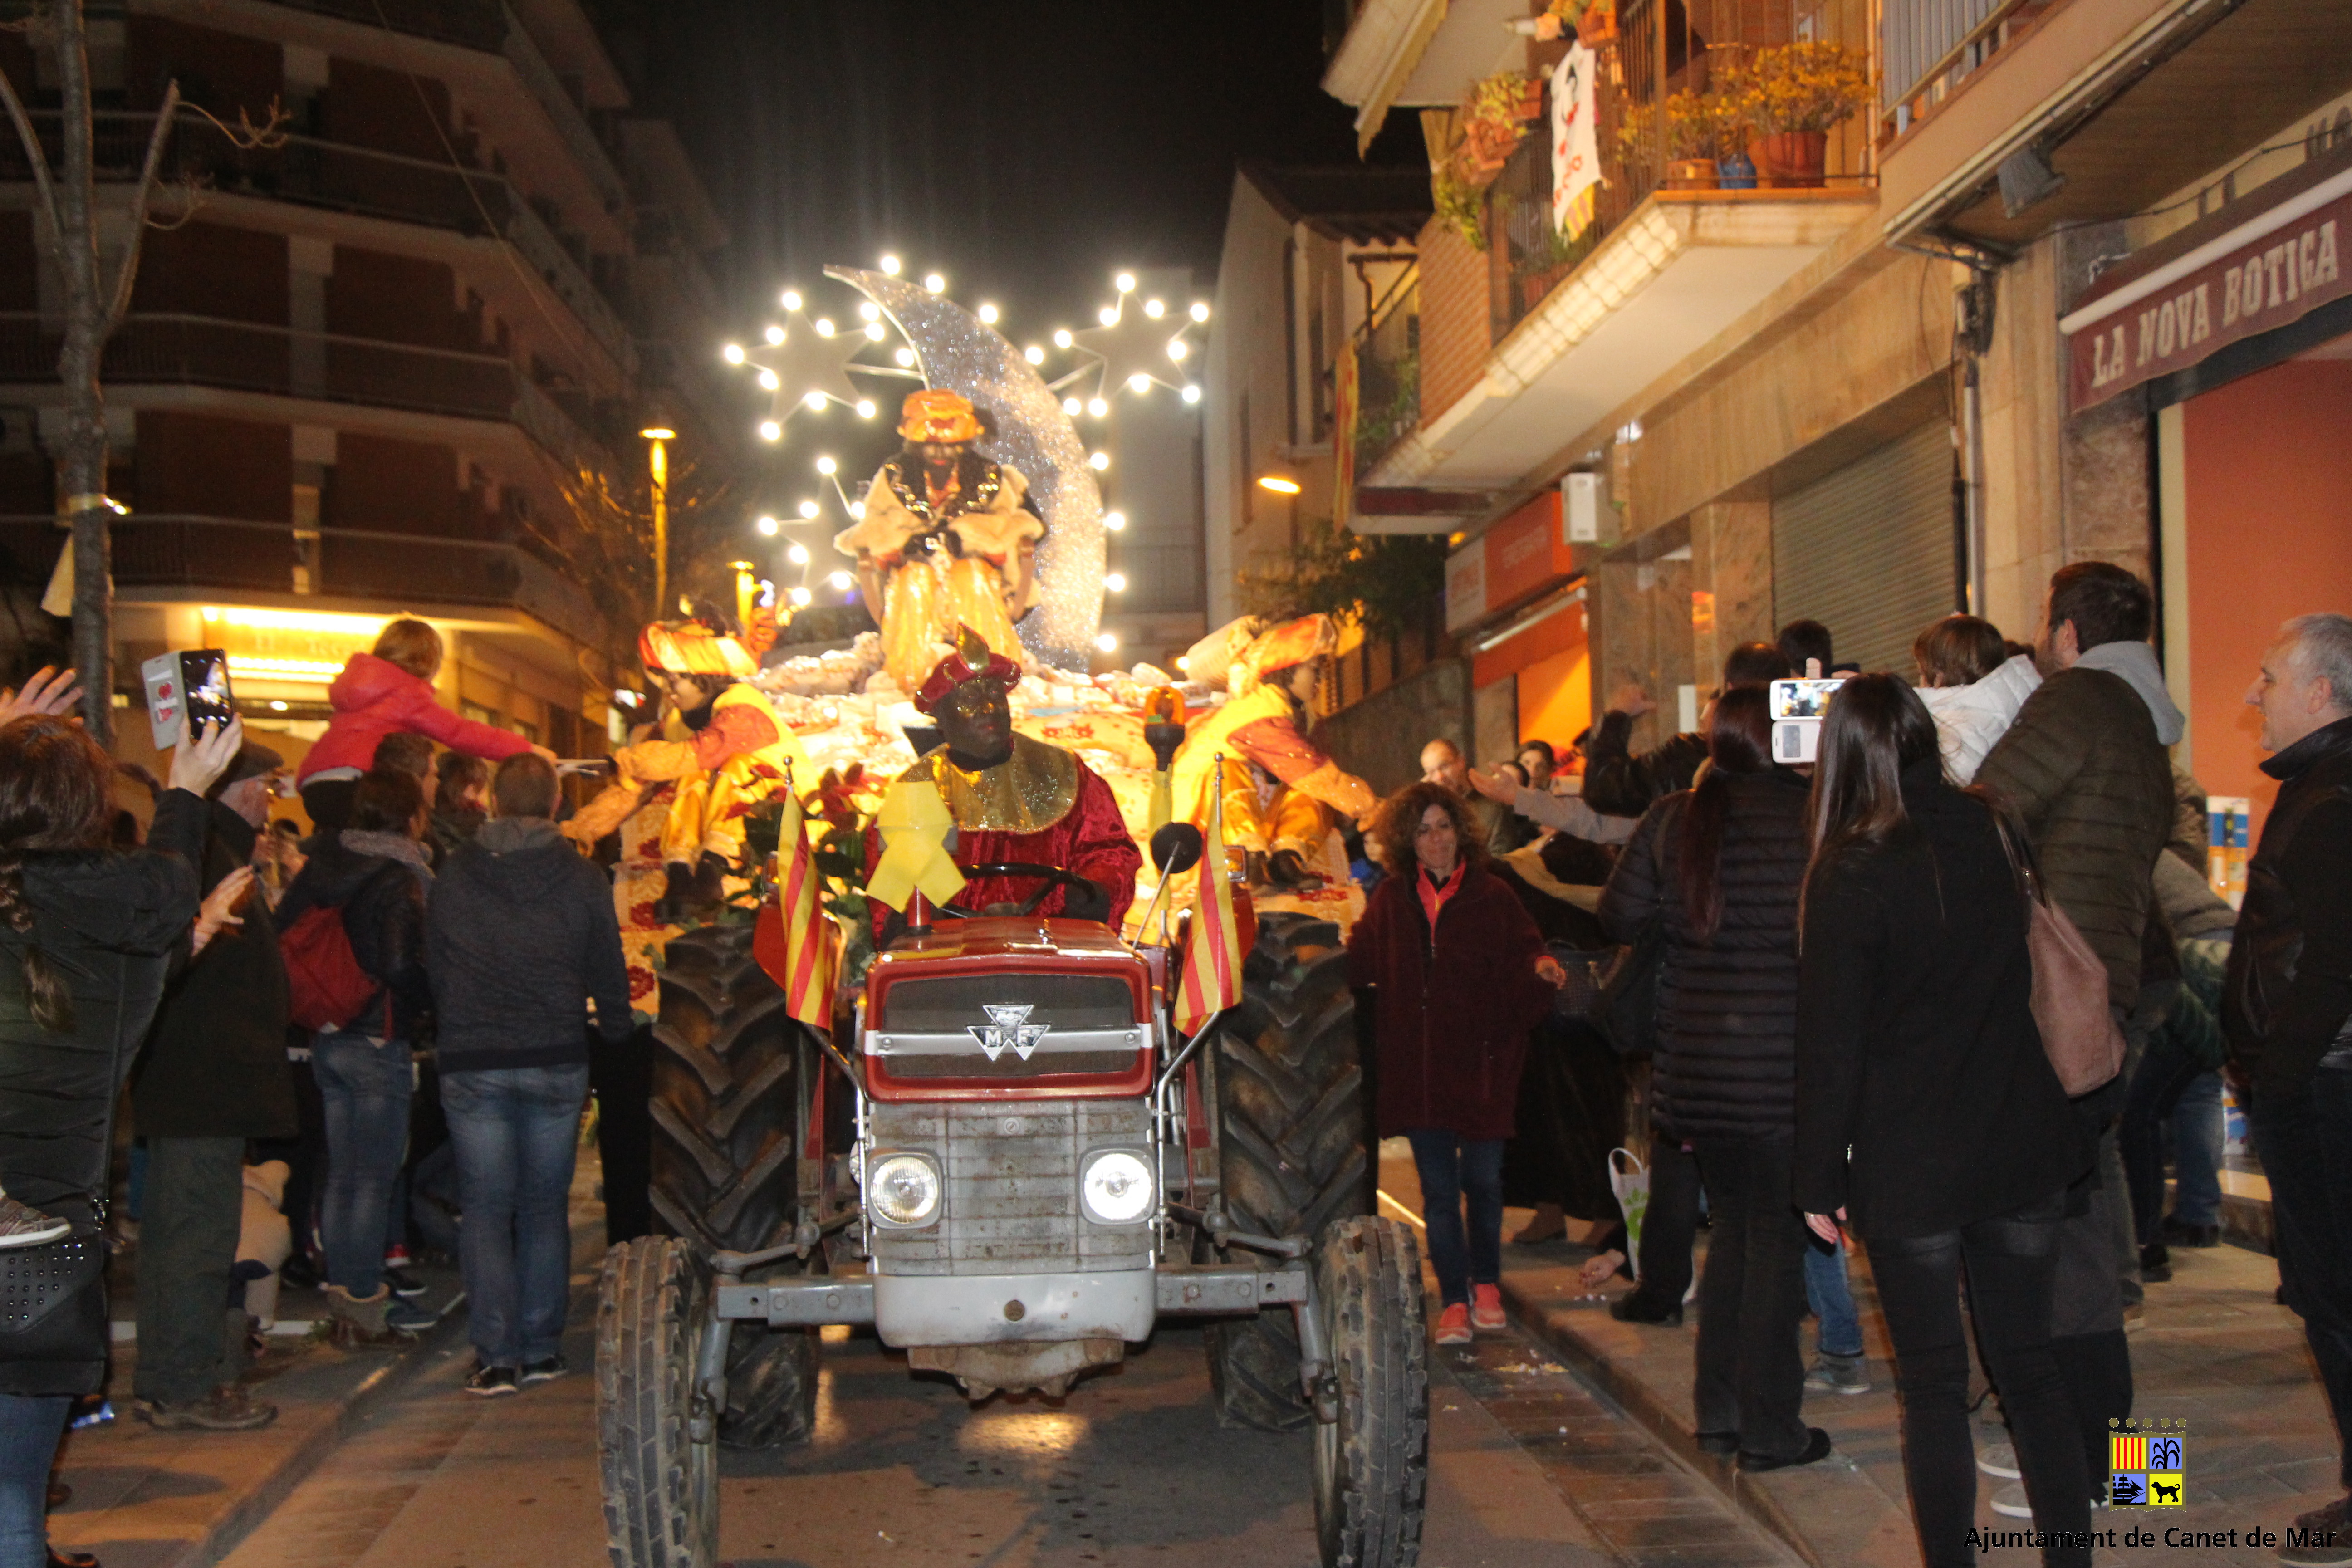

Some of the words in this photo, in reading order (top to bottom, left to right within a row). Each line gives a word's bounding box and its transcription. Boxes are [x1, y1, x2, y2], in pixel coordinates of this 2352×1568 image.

[2092, 324, 2127, 387] LA
[2136, 283, 2210, 367] NOVA
[2224, 220, 2339, 328] BOTIGA
